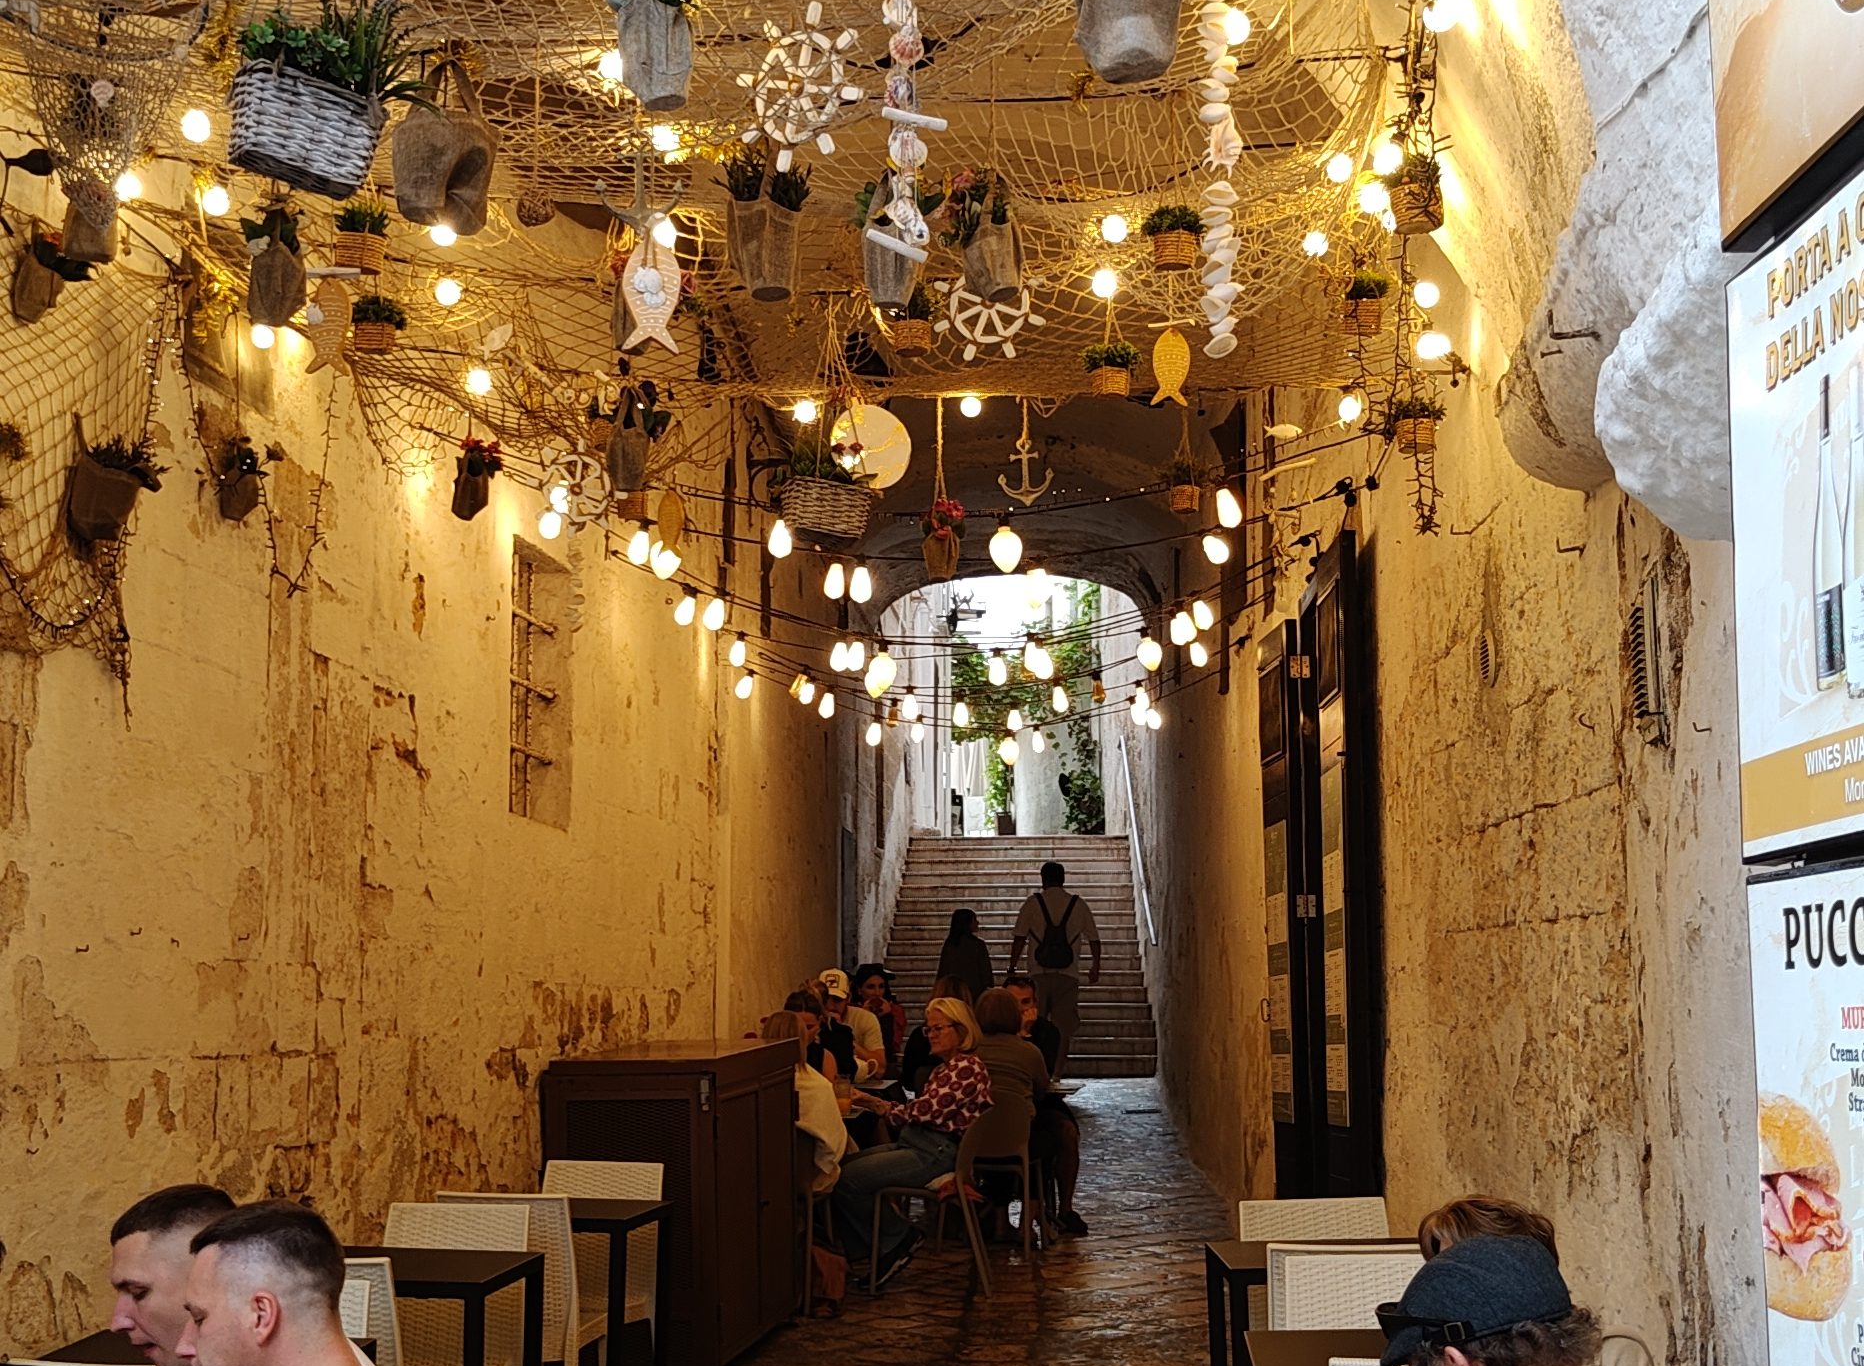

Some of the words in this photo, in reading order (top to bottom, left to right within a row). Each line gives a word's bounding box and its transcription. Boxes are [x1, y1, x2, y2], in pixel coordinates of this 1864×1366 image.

[1836, 207, 1851, 265] A
[1765, 304, 1826, 393] DELLA
[1804, 742, 1841, 777] WINES
[1782, 896, 1864, 970] PUCC
[1829, 1042, 1860, 1063] Crema
